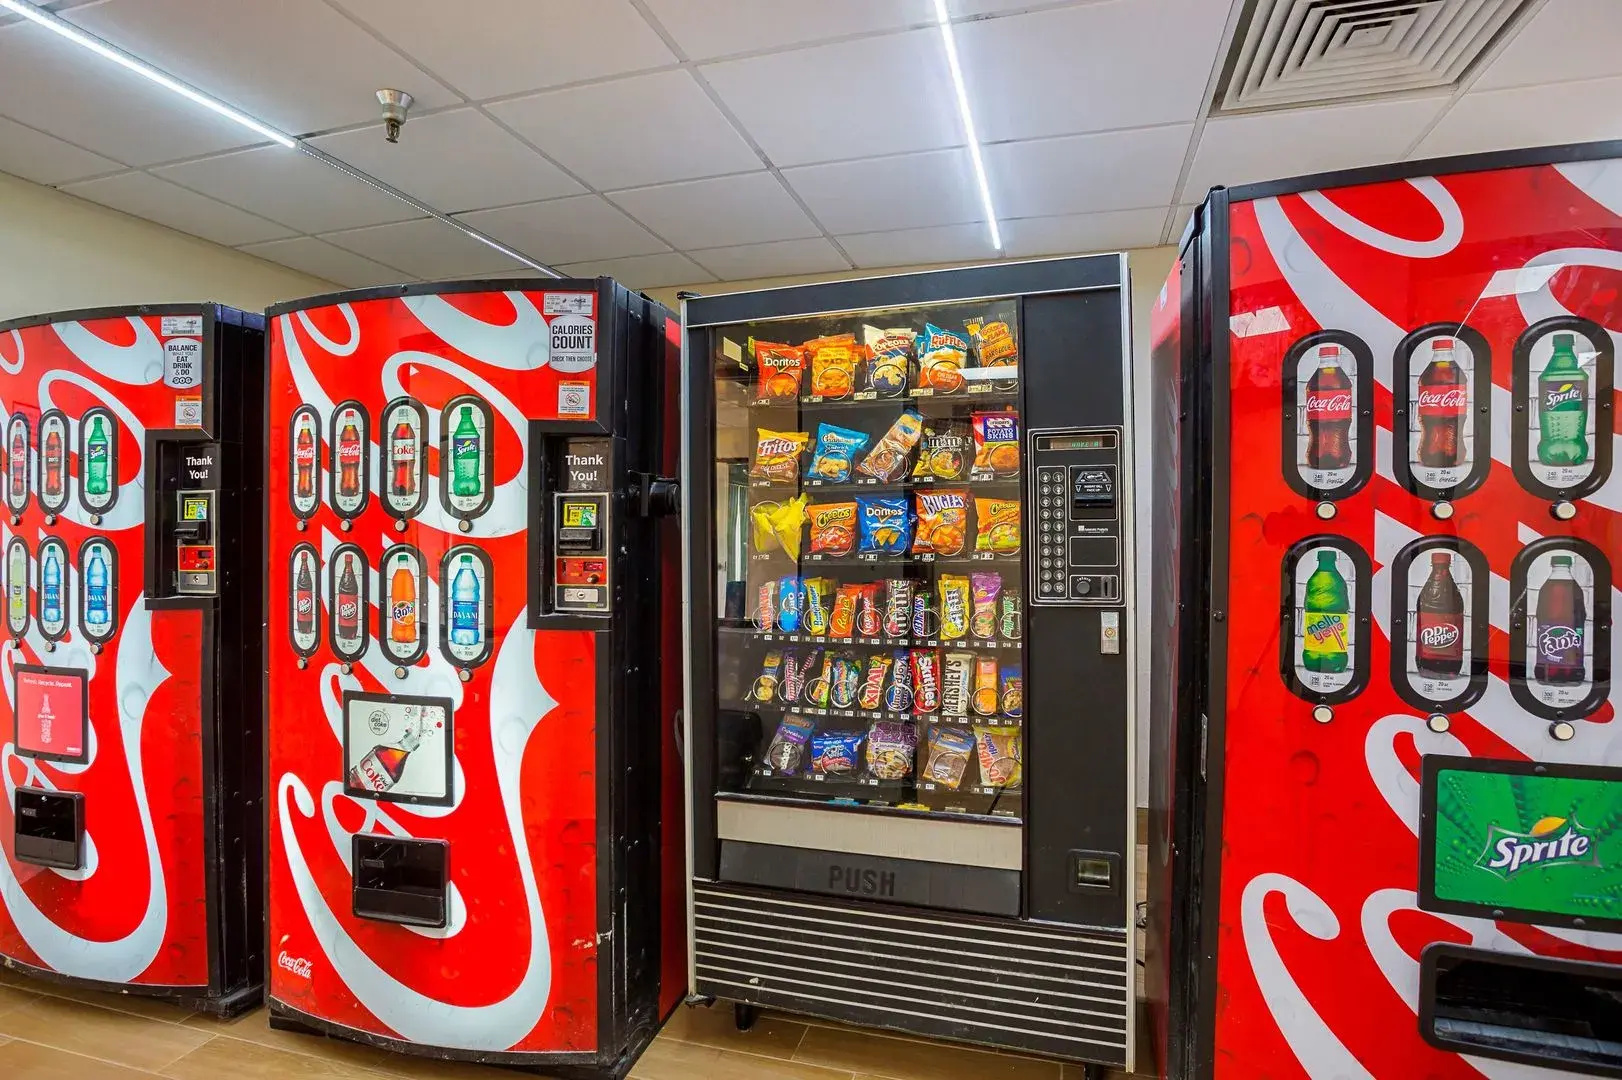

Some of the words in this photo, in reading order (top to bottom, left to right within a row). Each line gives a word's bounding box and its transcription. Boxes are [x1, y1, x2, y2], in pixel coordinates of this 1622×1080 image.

[552, 325, 593, 335] CALORIES
[168, 344, 198, 352] BALANCE
[552, 336, 593, 349] COUNT
[931, 334, 967, 350] RUFFLES
[765, 357, 801, 366] Doritos
[1306, 394, 1352, 413] Coca-Cola
[1418, 390, 1466, 408] Coca-Cola
[1546, 389, 1581, 408] Sprite
[392, 445, 414, 456] Coke
[759, 438, 798, 456] Fritos
[186, 455, 212, 466] Thank
[565, 454, 604, 465] Thank
[189, 470, 208, 480] You!
[570, 470, 598, 481] You!
[866, 507, 903, 517] Doritos
[922, 494, 965, 516] BUGLES
[816, 509, 851, 528] Cheetos
[393, 605, 414, 620] Fanta
[1306, 614, 1342, 638] mello
[1433, 627, 1449, 638] Dr
[1313, 622, 1345, 651] yello
[1420, 628, 1460, 646] Pepper
[1538, 630, 1582, 657] Fanta
[865, 664, 888, 705] TWIX
[919, 656, 936, 707] Skittles
[944, 660, 961, 714] HERSHEY'S
[362, 758, 385, 792] Coke
[1488, 825, 1590, 872] Sprite
[828, 865, 897, 897] PUSH
[277, 950, 314, 980] Coca-Cola
